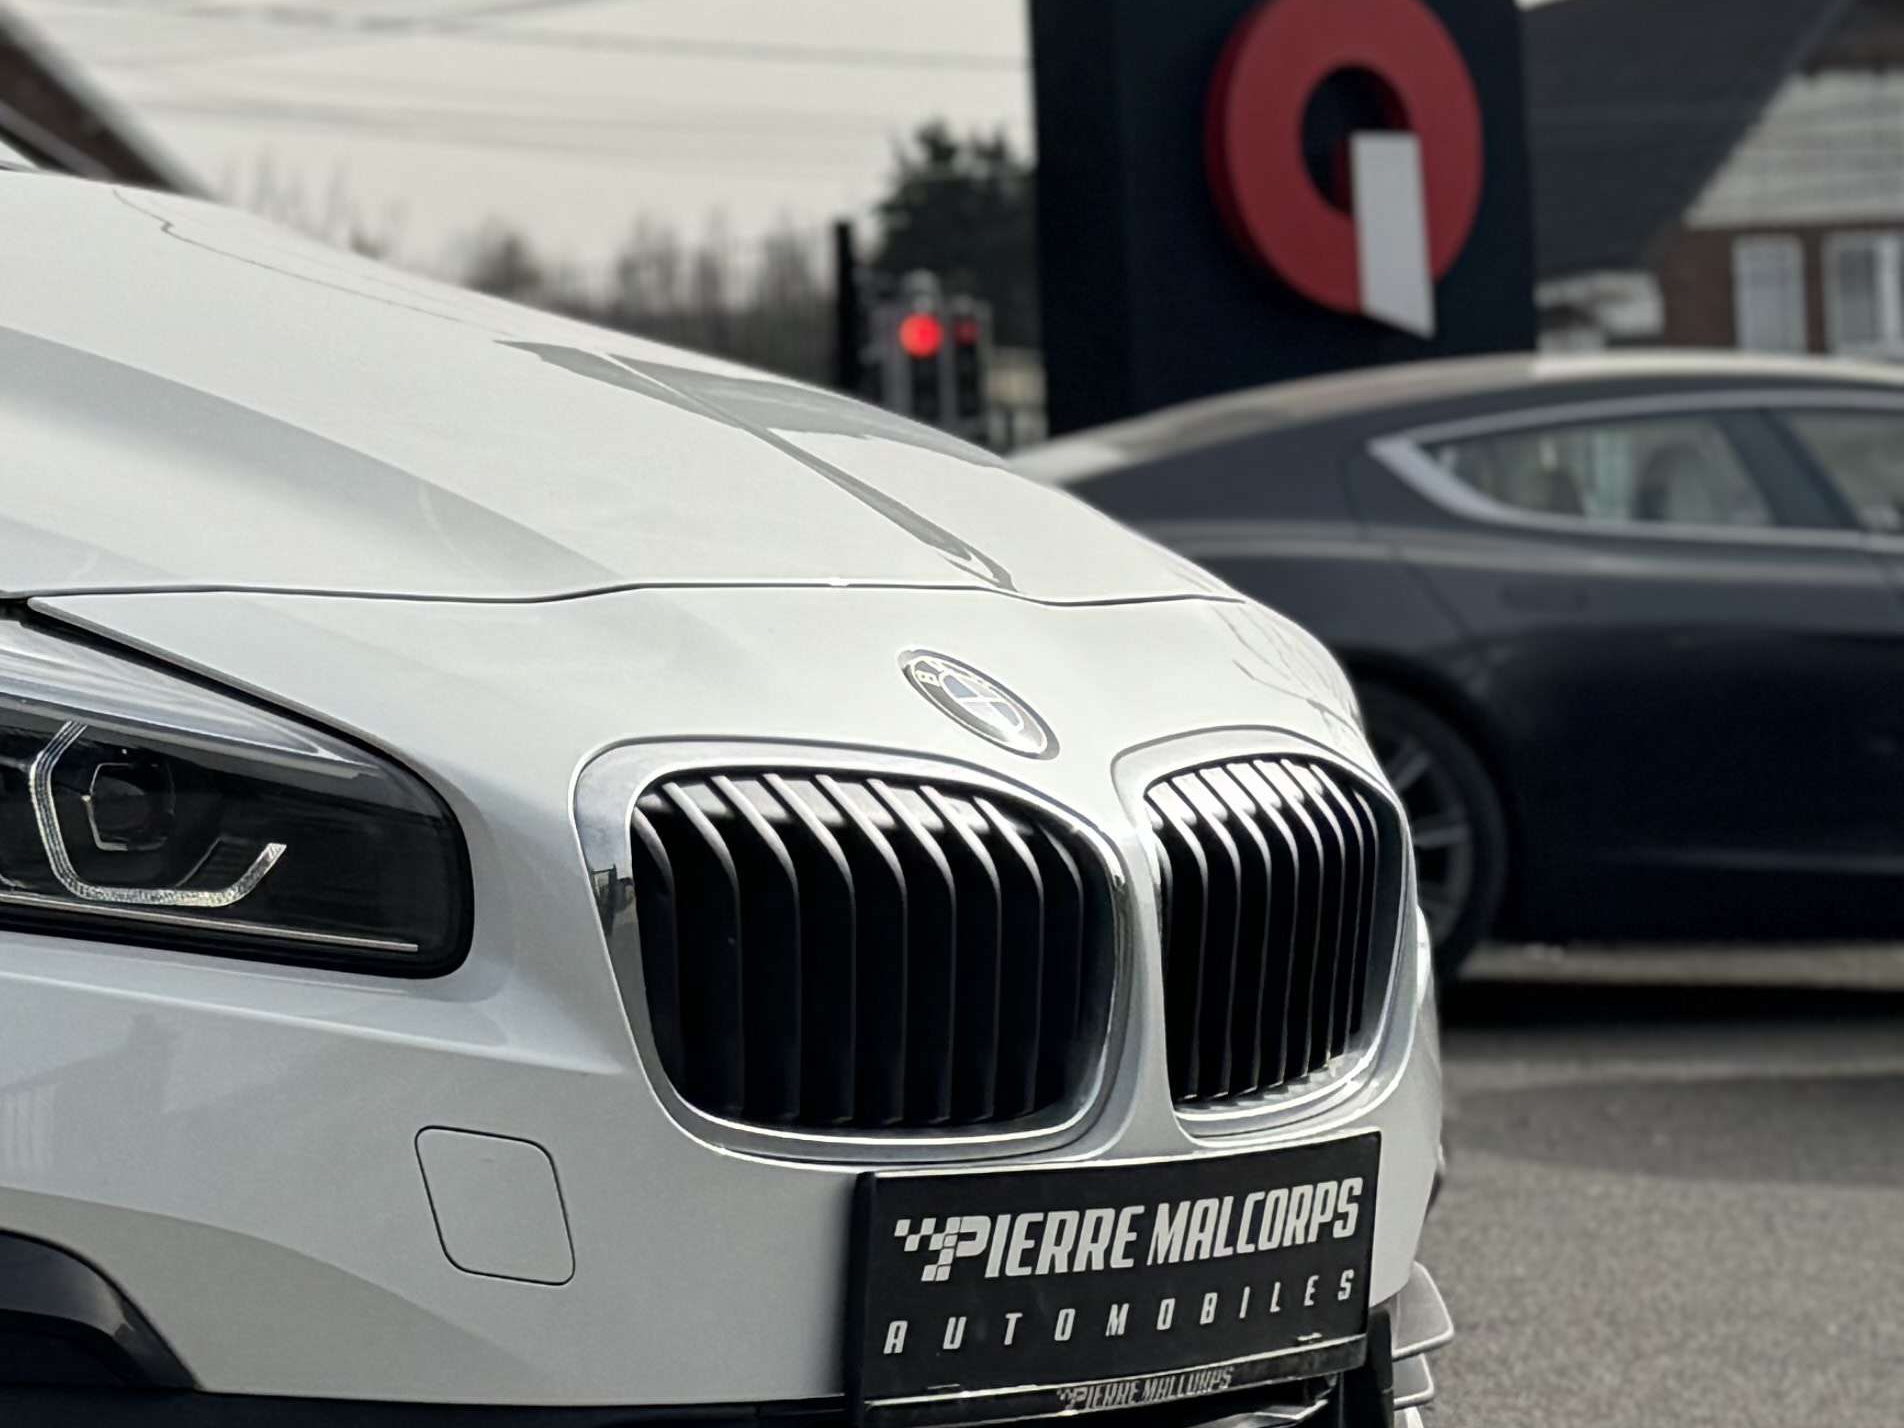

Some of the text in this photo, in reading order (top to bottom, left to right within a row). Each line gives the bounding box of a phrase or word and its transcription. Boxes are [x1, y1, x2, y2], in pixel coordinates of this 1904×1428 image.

[921, 1176, 1364, 1282] PIERRE MALCORPS
[882, 1269, 1356, 1355] AUTOMOBILES
